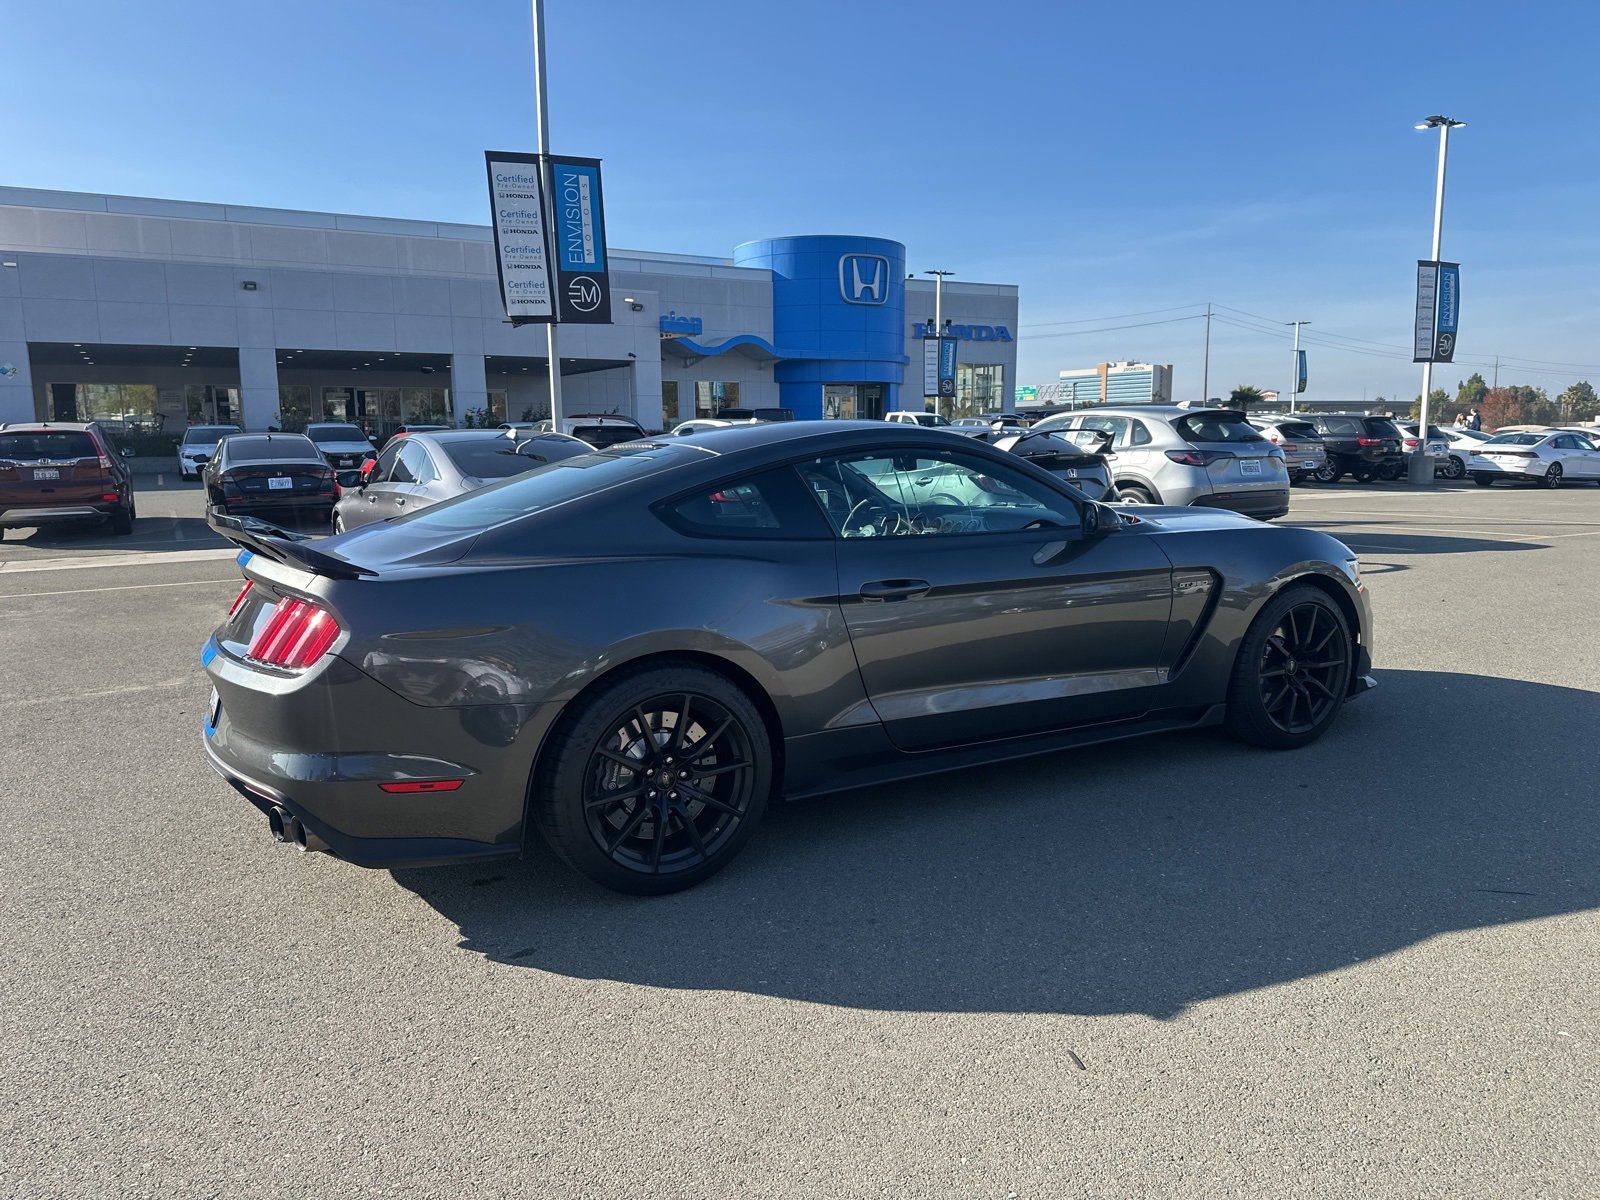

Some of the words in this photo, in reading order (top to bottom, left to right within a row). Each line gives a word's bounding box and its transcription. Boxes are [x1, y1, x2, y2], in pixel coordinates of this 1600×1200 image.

[496, 173, 534, 183] Certified
[500, 210, 538, 219] Certified
[563, 173, 584, 263] ENVISION
[582, 183, 593, 256] MOTORS
[503, 245, 542, 254] Certified
[507, 280, 545, 289] Certified
[1442, 272, 1451, 327] ENVISION
